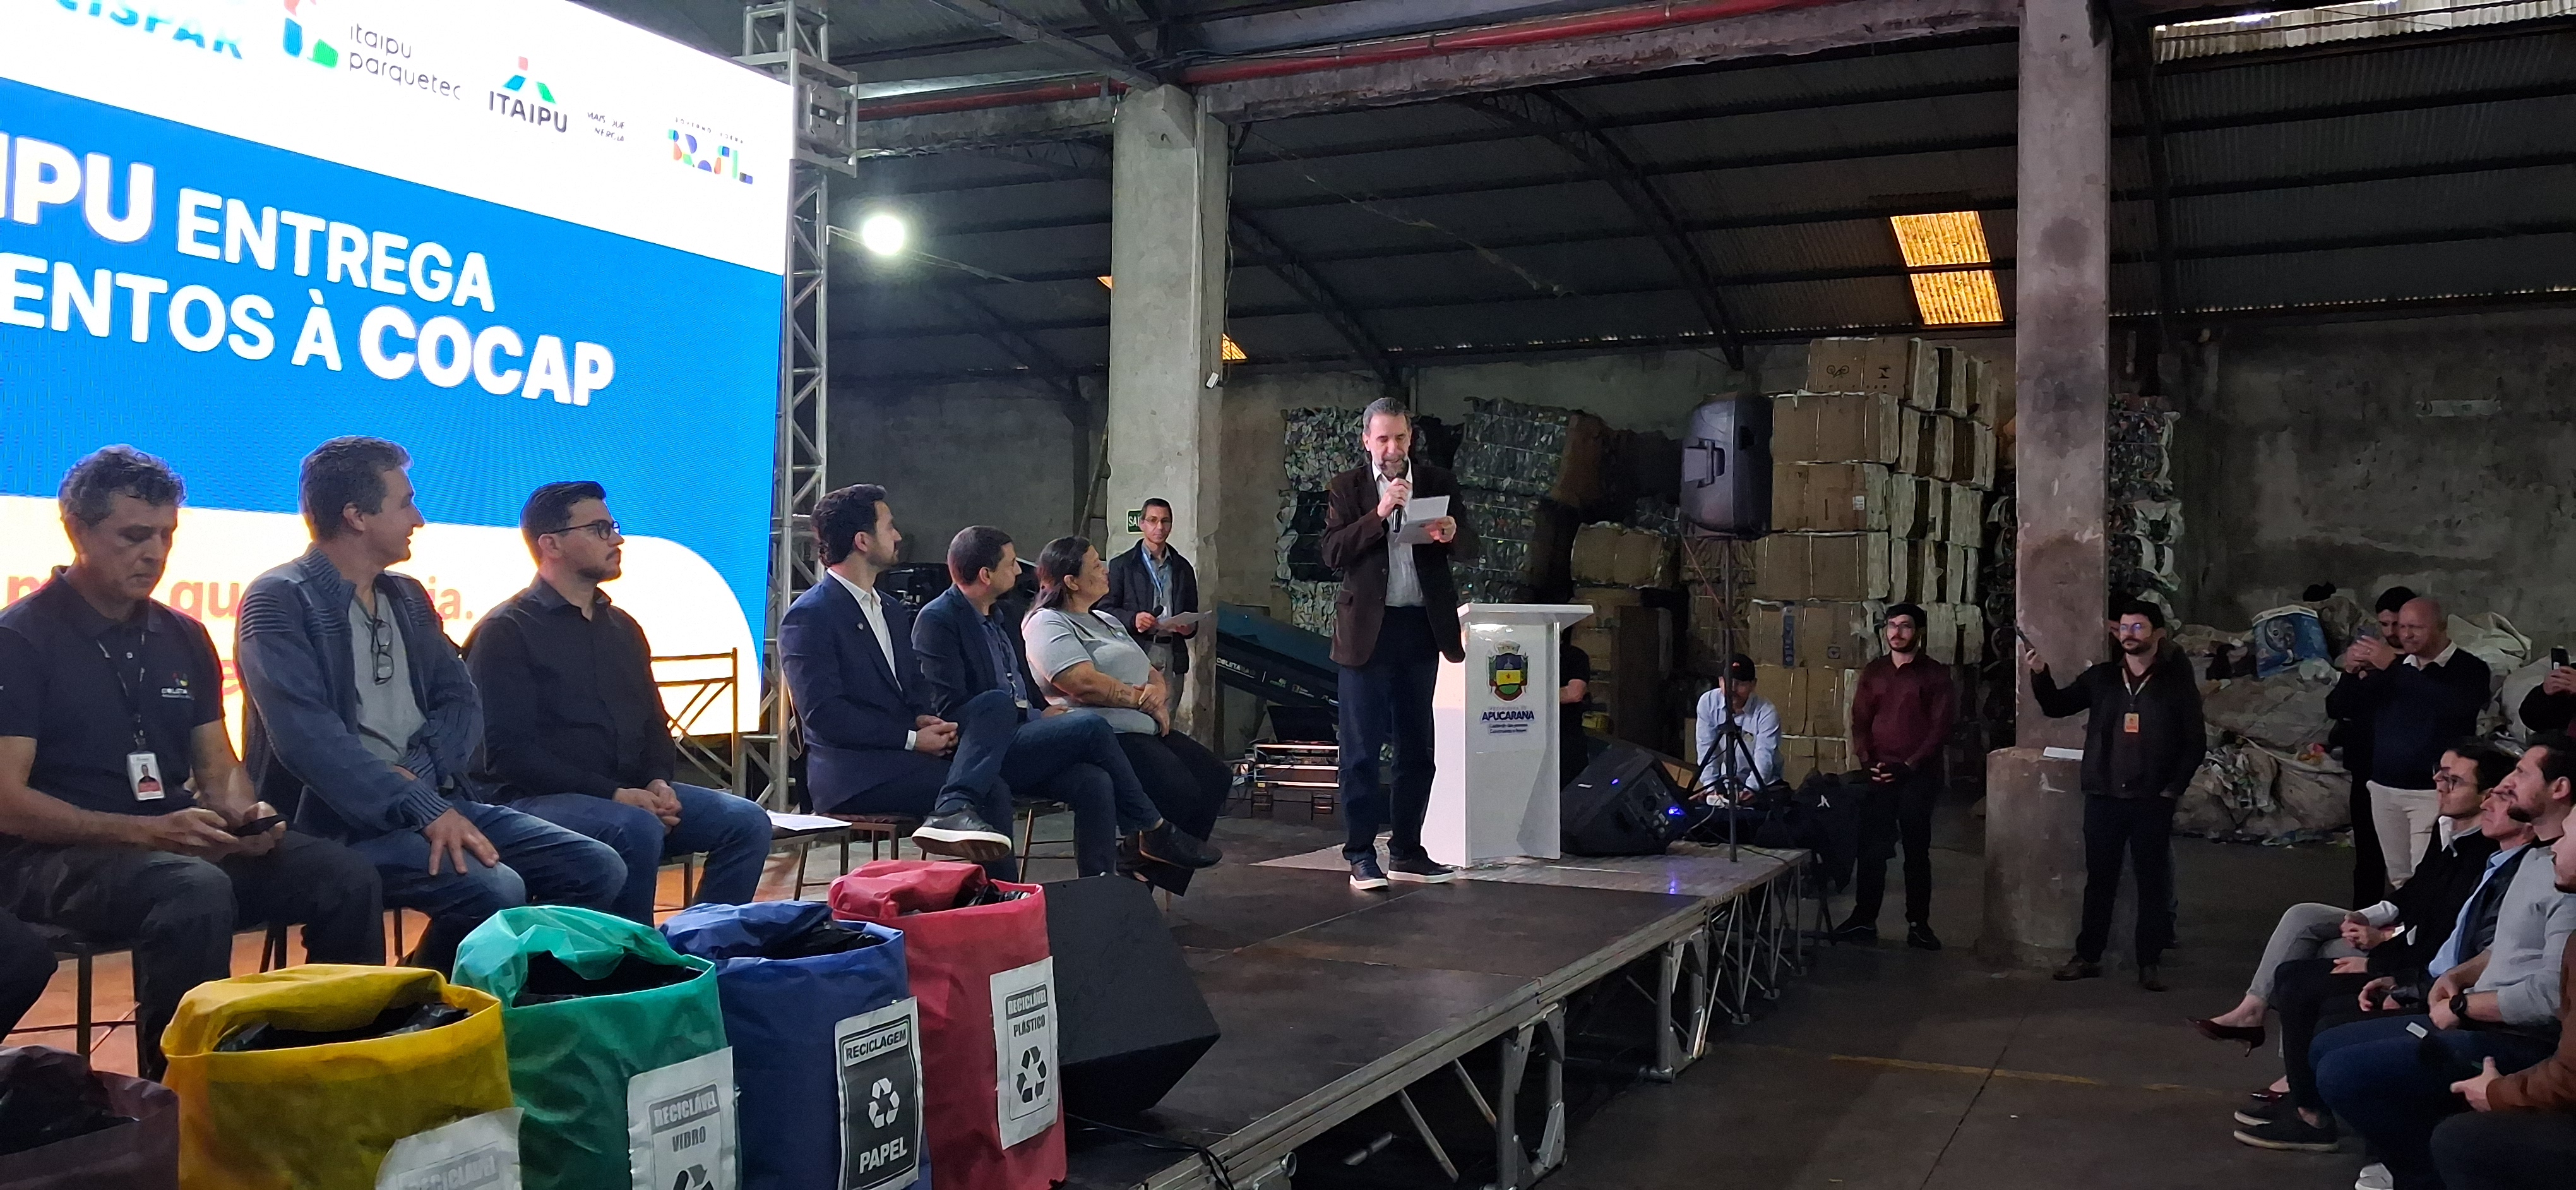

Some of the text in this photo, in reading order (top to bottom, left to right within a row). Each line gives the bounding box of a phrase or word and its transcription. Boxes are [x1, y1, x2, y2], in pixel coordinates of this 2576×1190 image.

[350, 23, 412, 59] itaipu
[349, 51, 462, 100] parquetec
[489, 90, 568, 133] ITAIPU
[177, 187, 496, 313] ENTREGA
[0, 252, 615, 407] ENTOS À COCAP
[1482, 710, 1535, 721] APUCARANA
[1013, 1014, 1046, 1037] PLÁSTICO
[845, 1028, 907, 1060] RECICLAGEM
[653, 1091, 718, 1127] RECICLÁVEL
[672, 1126, 706, 1153] VIDRO
[859, 1137, 907, 1174] PAPEL
